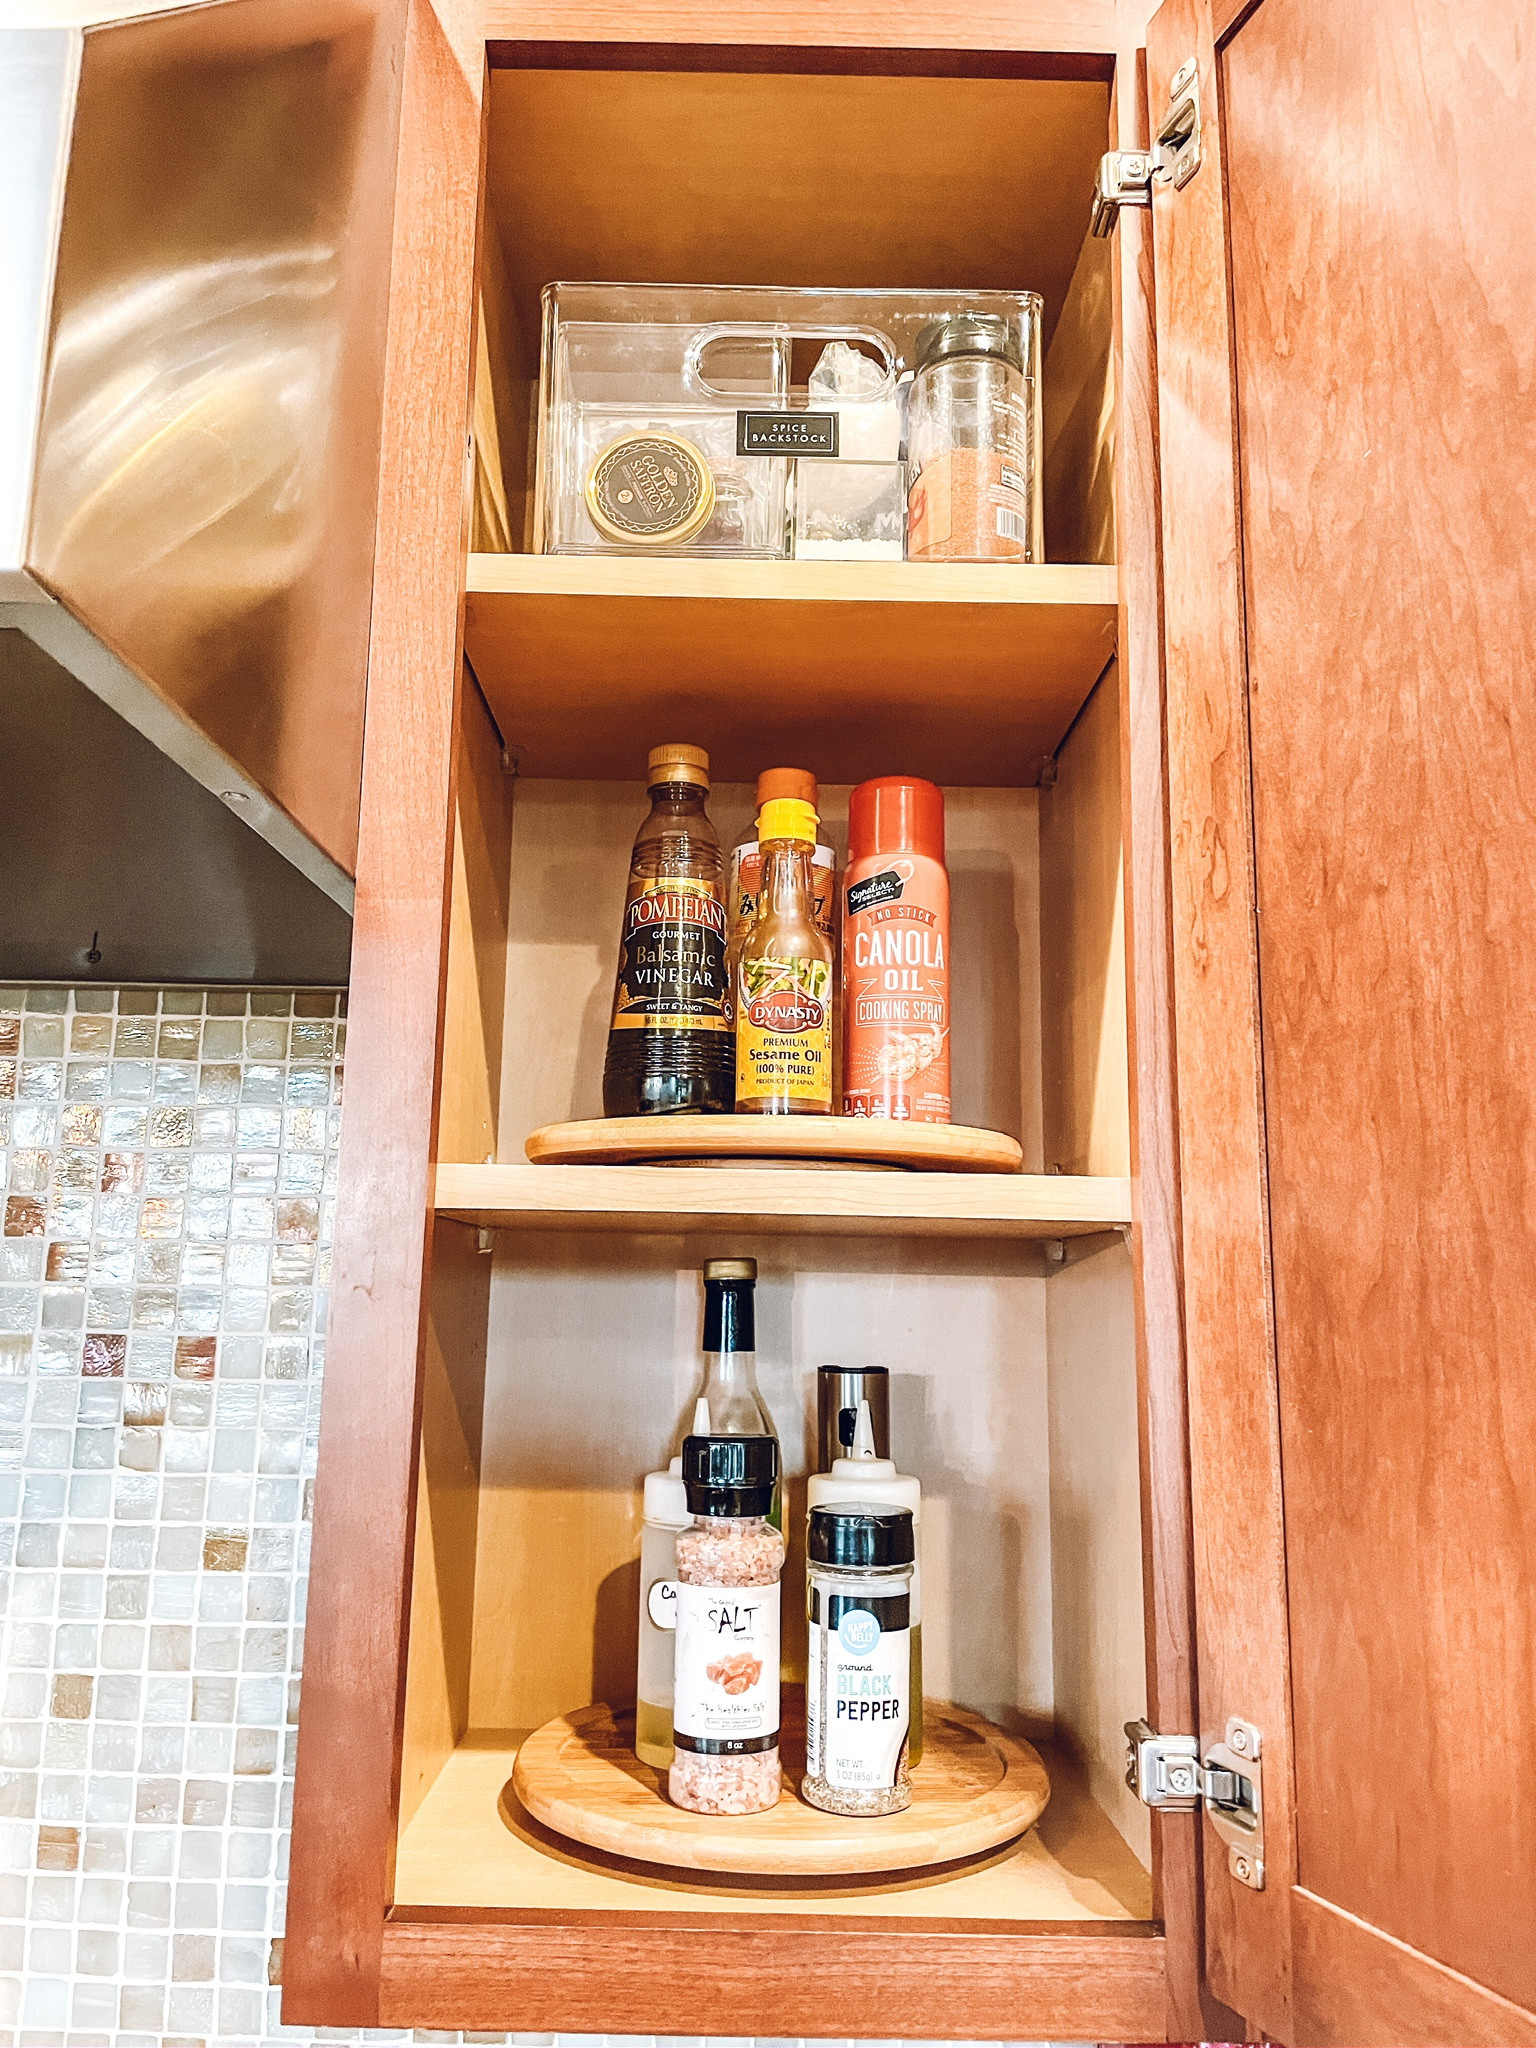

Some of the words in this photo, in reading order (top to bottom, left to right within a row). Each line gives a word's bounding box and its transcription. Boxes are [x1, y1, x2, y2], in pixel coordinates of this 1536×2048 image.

[772, 424, 807, 432] SPICE
[752, 433, 827, 443] BACKSTOCK
[630, 459, 665, 513] SAFFRON
[641, 455, 679, 509] GOLDEN
[850, 881, 893, 903] Signature
[631, 896, 722, 930] POMPEIAN
[877, 908, 891, 920] NO
[898, 907, 931, 923] STICK
[652, 930, 701, 941] GOURMET
[637, 944, 716, 967] Balsamic
[855, 929, 945, 971] CANOLA
[635, 968, 715, 988] VINEGAR
[884, 968, 924, 992] OIL
[646, 1003, 670, 1011] SWEET
[681, 1004, 703, 1012] TANGY
[755, 1005, 820, 1021] DYNASTY
[859, 999, 909, 1021] COOKING
[913, 1000, 943, 1022] SPRAY
[763, 1037, 809, 1047] PREMIUM
[749, 1048, 801, 1061] Sesame
[804, 1049, 822, 1063] Oil
[755, 1063, 784, 1074] (100%
[787, 1064, 815, 1076] PURE)
[708, 1606, 760, 1634] SALT
[847, 1620, 873, 1633] HAPPY
[850, 1631, 874, 1643] BELLY
[837, 1663, 874, 1673] ground
[837, 1674, 892, 1696] BLACK
[836, 1699, 900, 1721] PEPPER
[727, 1741, 733, 1749] 8
[836, 1758, 850, 1768] NET
[854, 1772, 873, 1783] (85g)
